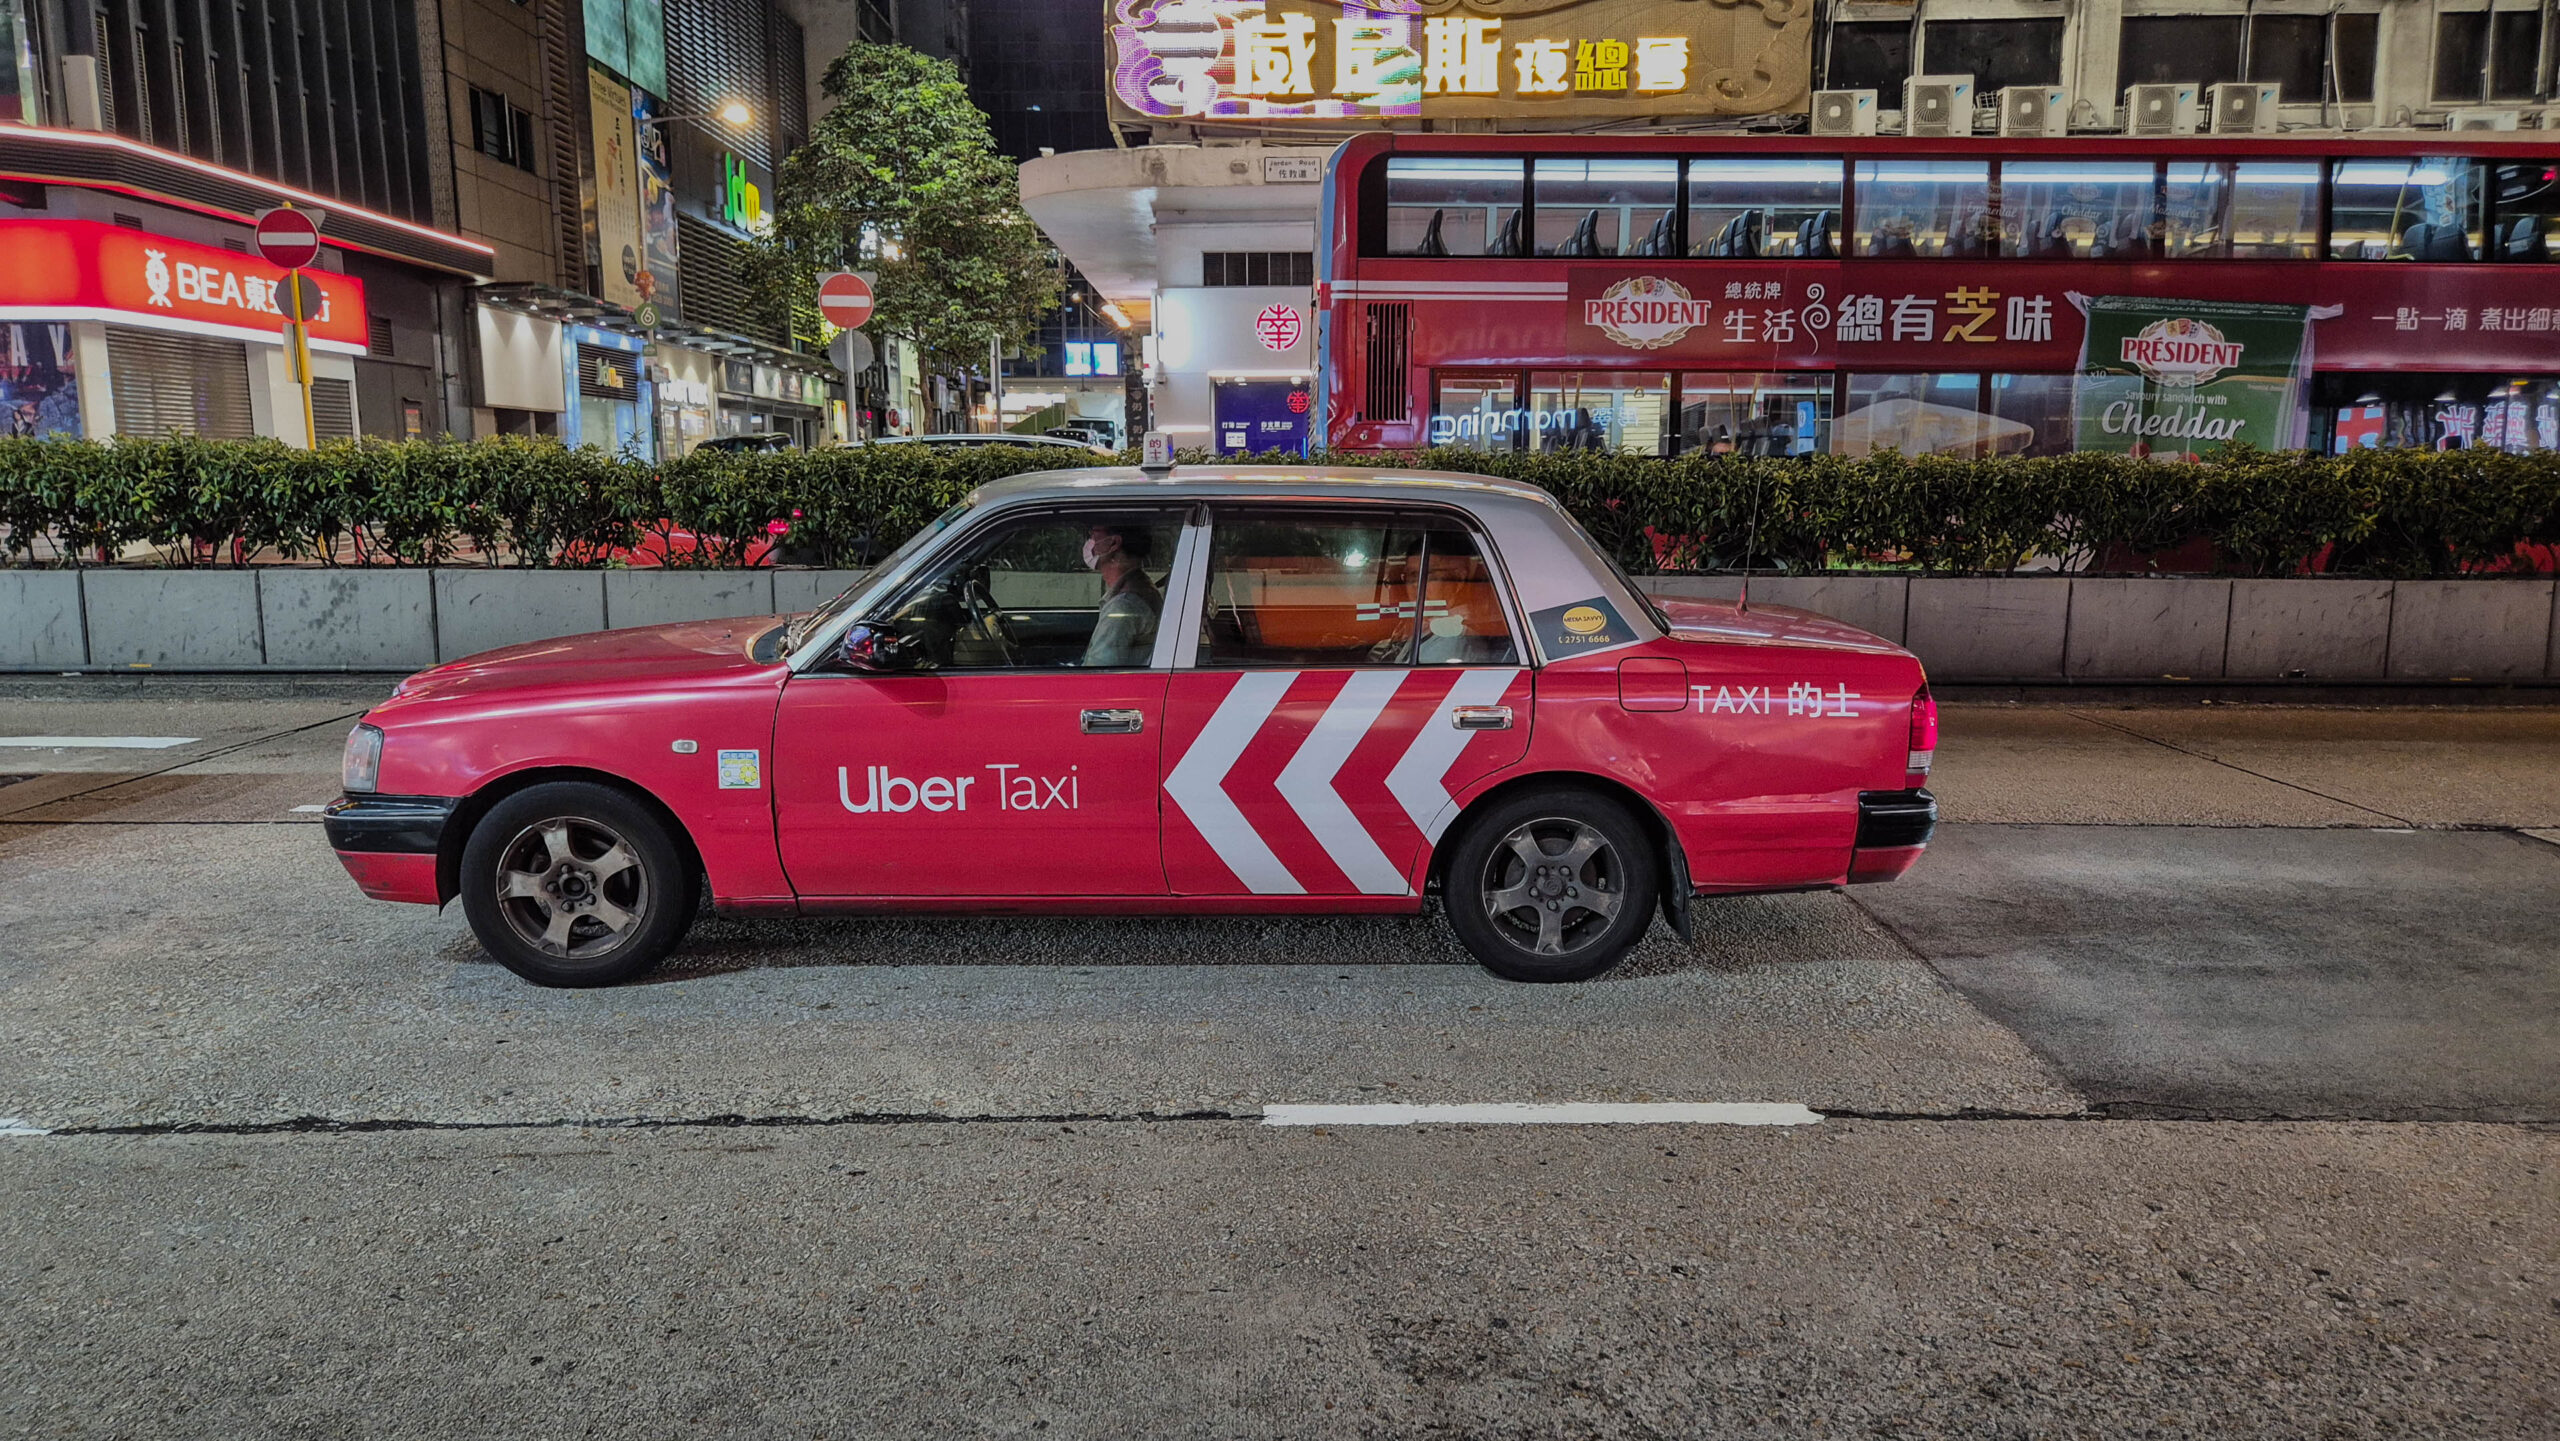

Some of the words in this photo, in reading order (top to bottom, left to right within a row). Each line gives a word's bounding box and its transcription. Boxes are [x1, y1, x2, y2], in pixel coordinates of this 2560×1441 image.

[1298, 159, 1316, 167] Road
[2061, 203, 2102, 220] Cheddar
[176, 261, 244, 309] BEA
[1724, 281, 1782, 300] 總統牌
[1587, 296, 1710, 329] PRÉSIDENT
[1722, 307, 1797, 343] 生活
[1836, 286, 2053, 342] 總有芝味
[2371, 306, 2469, 332] 一點一滴
[2122, 337, 2242, 367] PRÉSIDENT
[2125, 389, 2160, 402] Savoury
[2162, 392, 2205, 405] sandwich
[2206, 394, 2228, 406] with
[2101, 400, 2246, 441] Cheddar
[1149, 439, 1162, 461] 的士
[1565, 635, 1586, 643] 2751
[1588, 635, 1610, 643] 6666
[1690, 685, 1770, 714] TAXI
[1787, 681, 1861, 718] 的士
[837, 765, 975, 813] Uber
[985, 764, 1079, 811] Taxi
